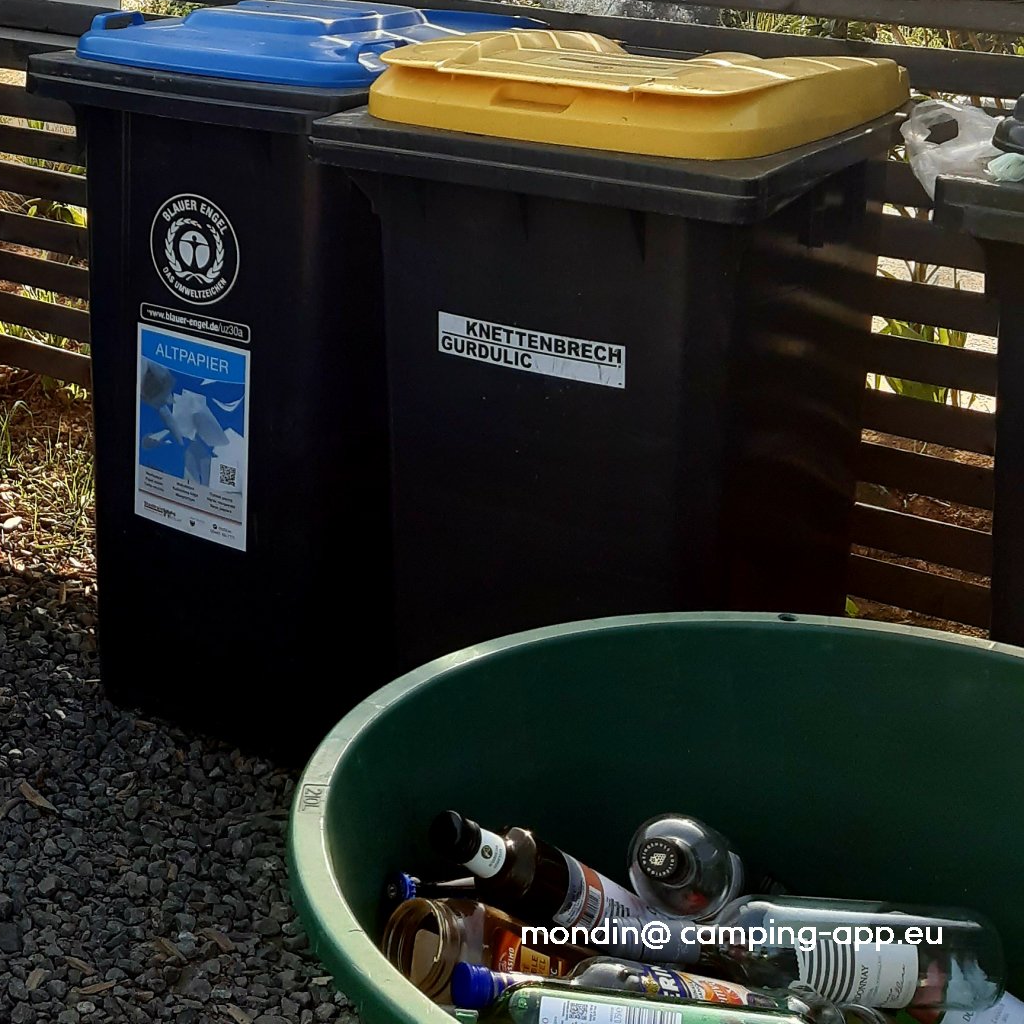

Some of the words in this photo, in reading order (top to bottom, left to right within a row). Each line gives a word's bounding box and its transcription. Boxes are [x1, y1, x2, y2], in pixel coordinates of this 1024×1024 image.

[161, 199, 198, 222] BLAUER
[199, 202, 227, 236] ENGEL
[162, 266, 175, 284] DAS
[174, 277, 228, 299] UMWELTZEICHEN
[155, 342, 229, 375] ALTPAPIER
[441, 335, 533, 369] GURDULIC
[465, 320, 623, 364] KNETTENBRECH
